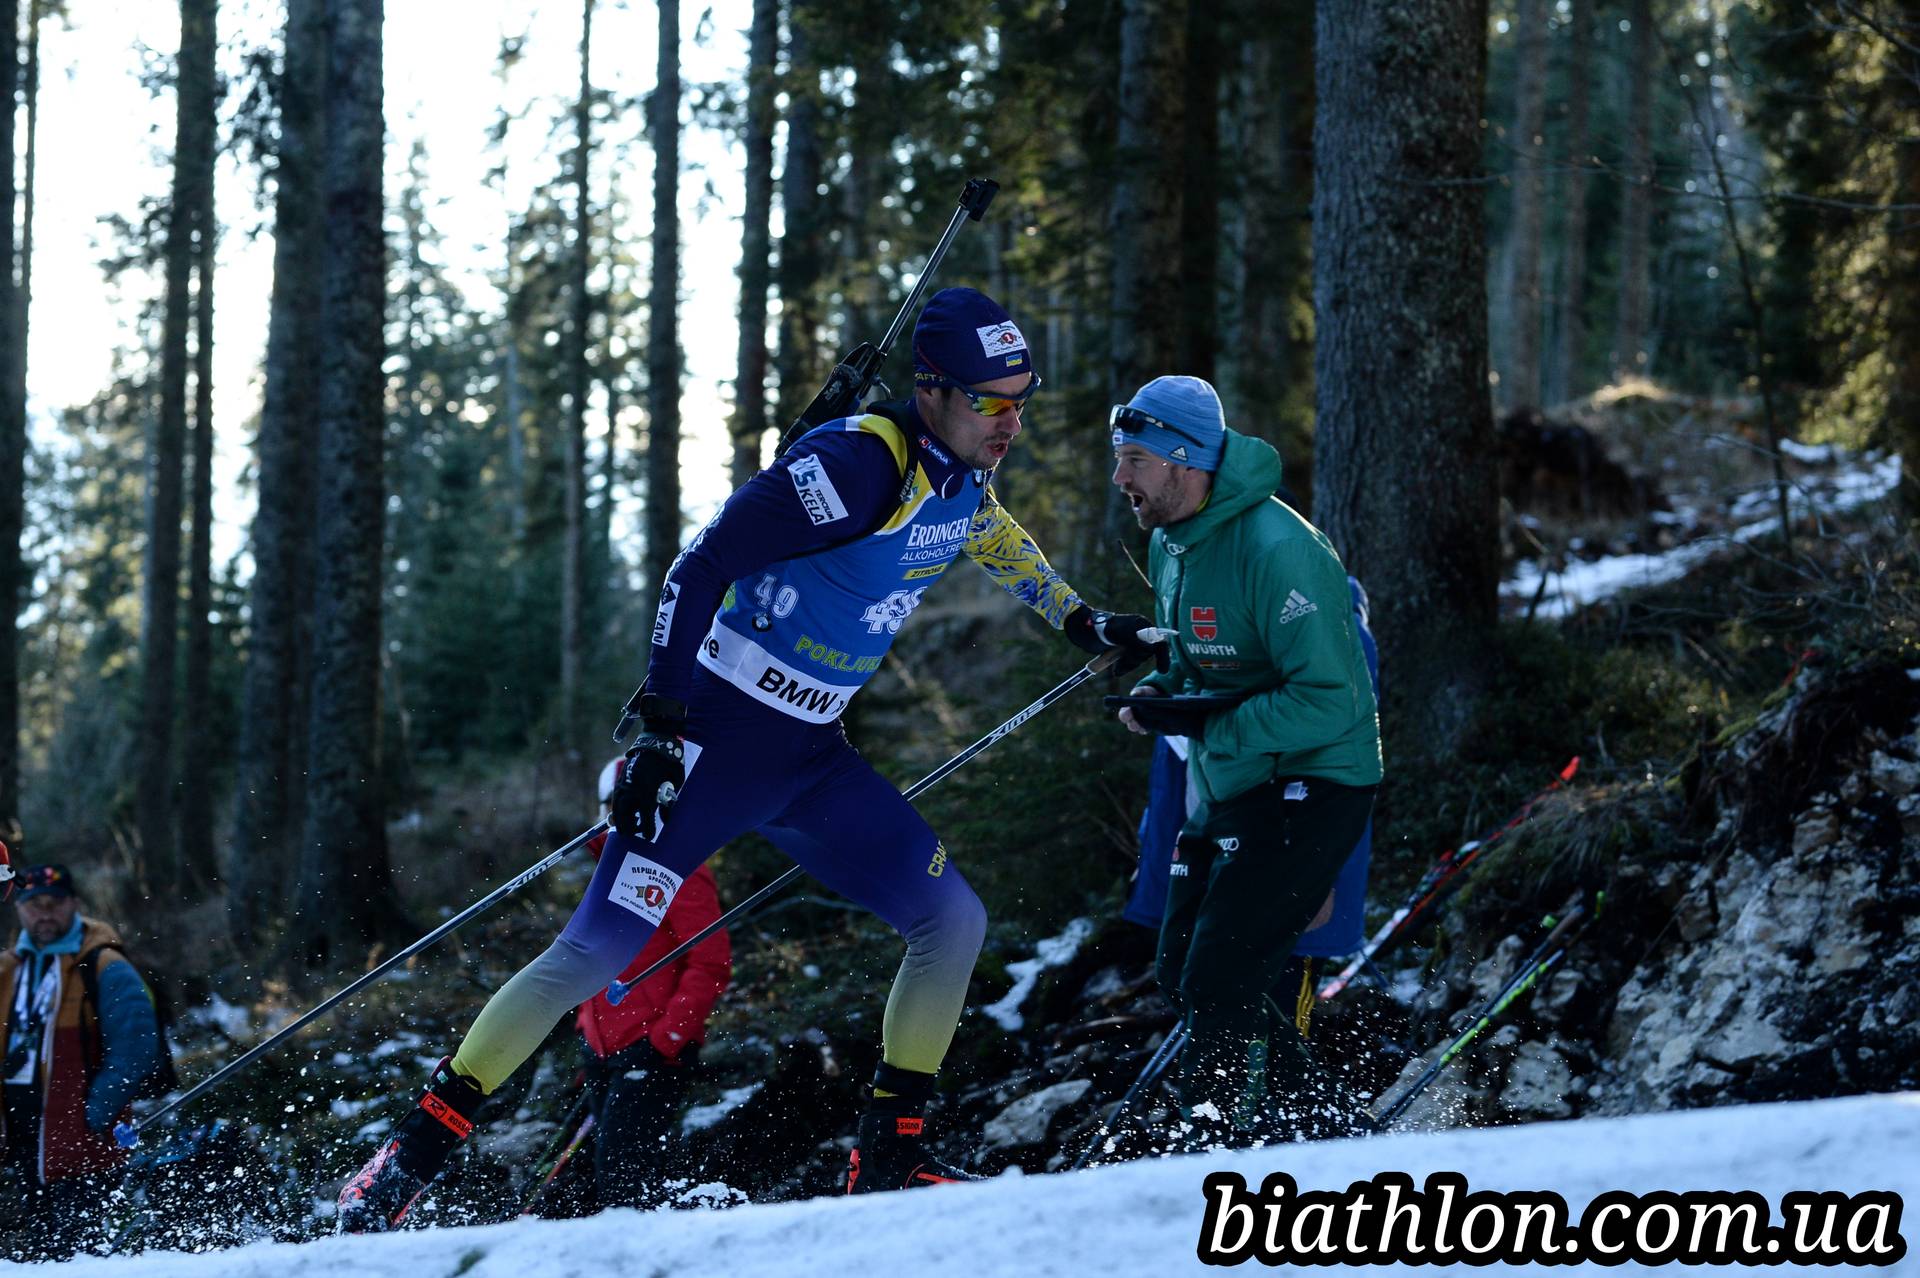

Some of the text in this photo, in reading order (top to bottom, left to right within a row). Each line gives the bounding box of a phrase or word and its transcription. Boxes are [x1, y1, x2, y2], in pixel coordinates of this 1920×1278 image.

[927, 443, 950, 466] LAPUA
[906, 517, 969, 548] ERDINGER
[910, 565, 944, 578] ZITRONE
[753, 572, 800, 619] 49
[653, 611, 668, 643] KAN
[1280, 603, 1318, 624] adidas
[756, 666, 839, 714] BMW
[631, 866, 658, 877] ПЕРША
